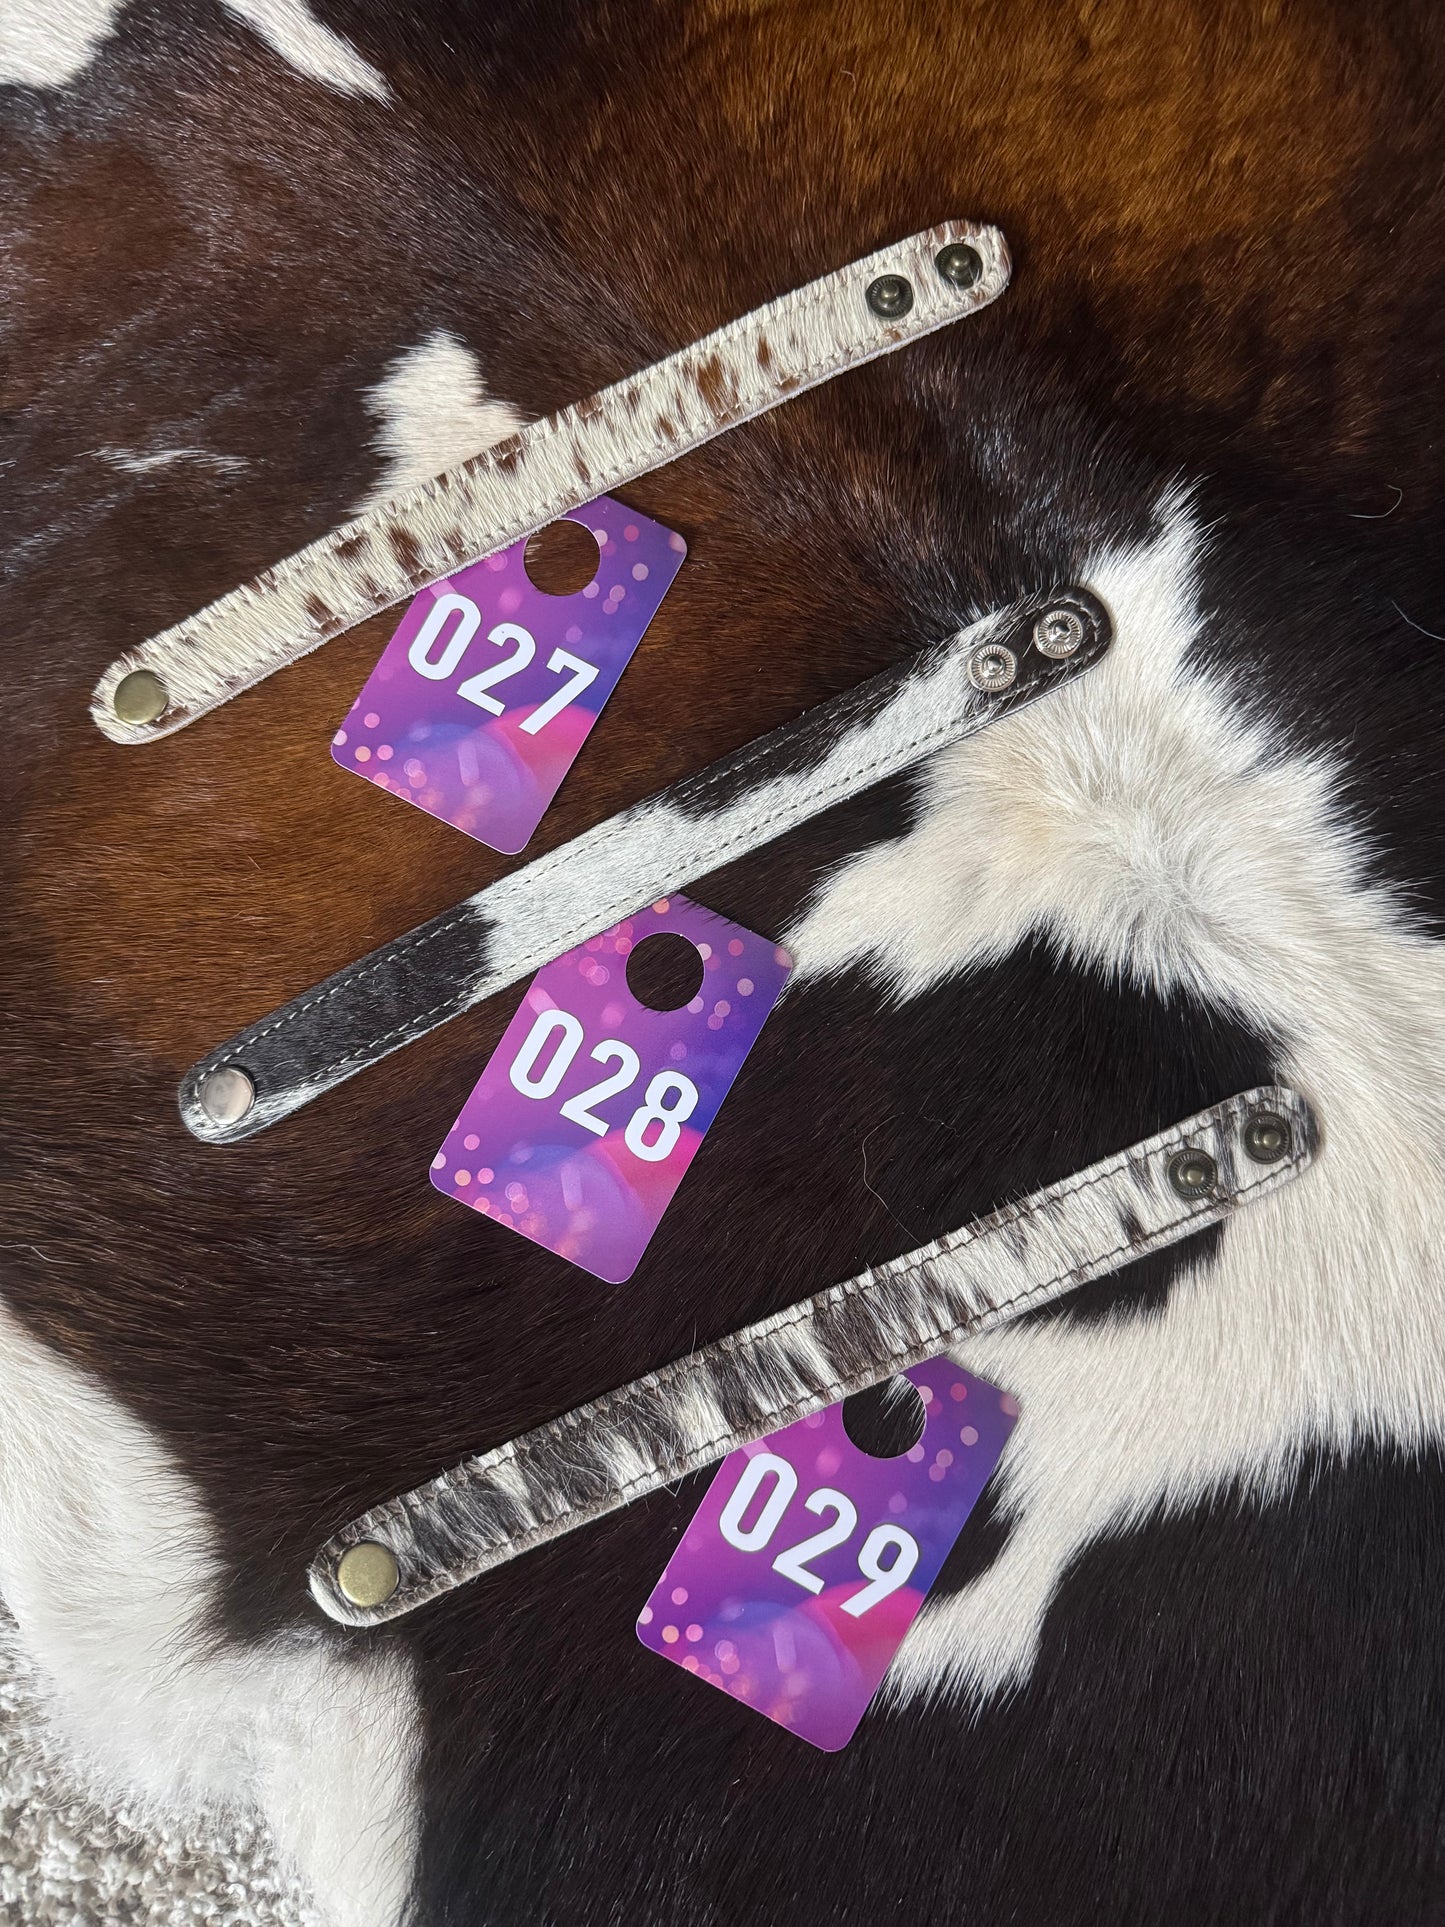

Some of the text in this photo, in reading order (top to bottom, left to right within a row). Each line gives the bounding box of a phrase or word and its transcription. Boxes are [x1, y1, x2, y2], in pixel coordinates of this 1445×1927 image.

[408, 593, 600, 736] 027
[509, 1008, 699, 1163] 028
[718, 1452, 920, 1619] 029
